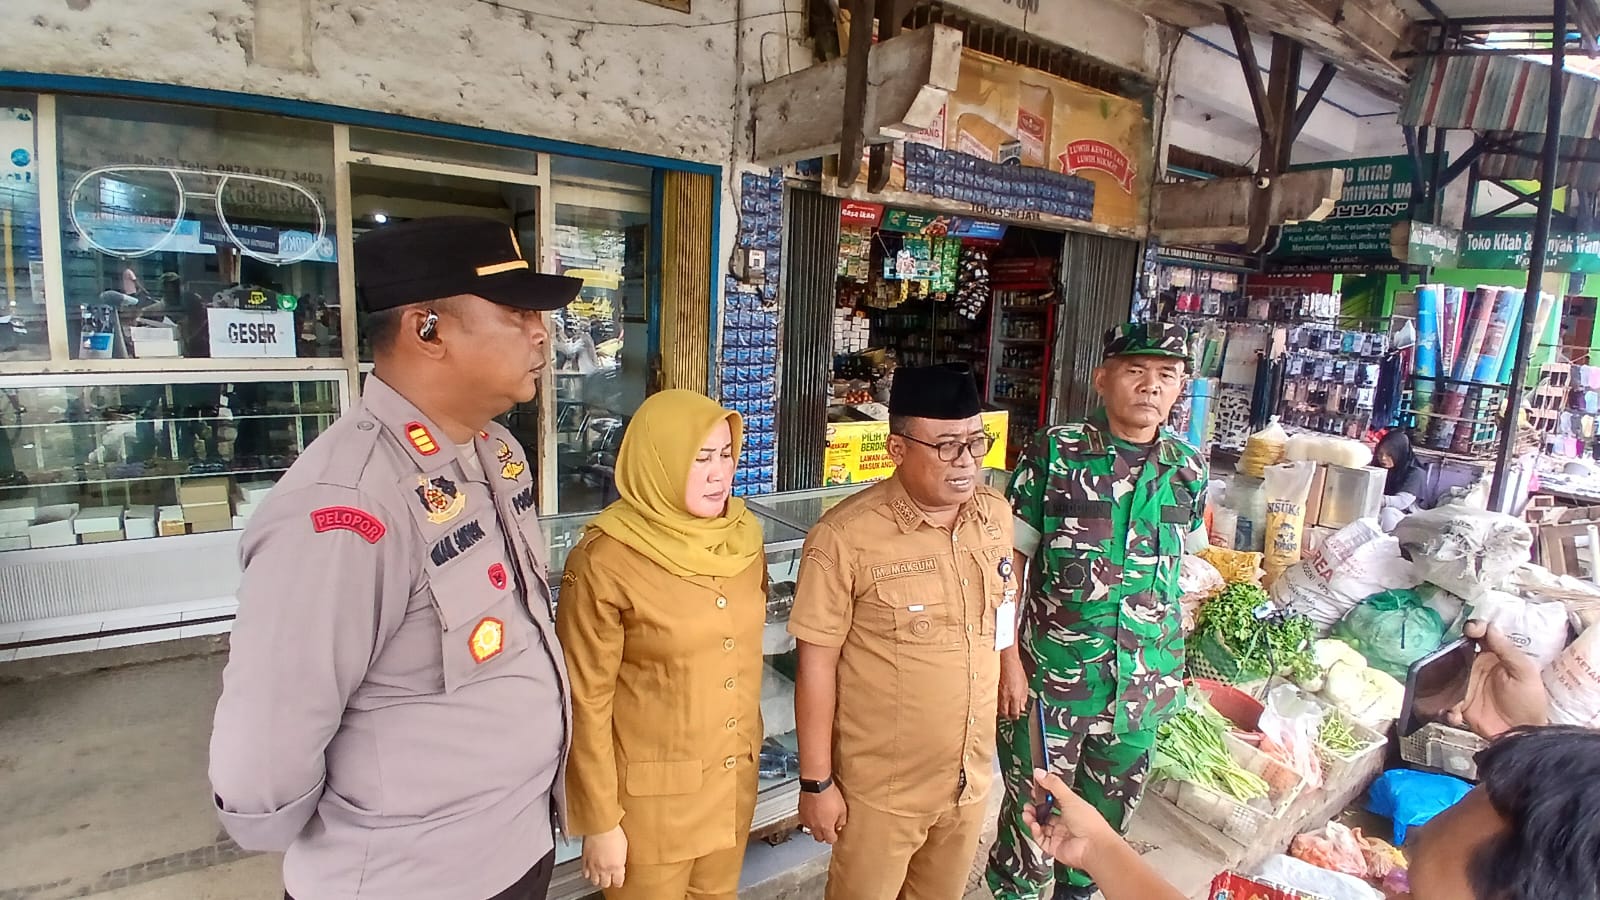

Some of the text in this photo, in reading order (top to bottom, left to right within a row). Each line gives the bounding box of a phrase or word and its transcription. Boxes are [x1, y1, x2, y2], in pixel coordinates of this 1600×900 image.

[292, 170, 323, 184] 3403
[1357, 164, 1393, 182] KITAB
[1467, 234, 1491, 251] Toko
[1493, 233, 1522, 251] Kitab
[228, 322, 277, 344] GESER
[861, 431, 882, 443] PILIH
[860, 454, 880, 462] LAWAN
[315, 511, 380, 538] PELOPOR
[891, 558, 936, 575] MAKSUM
